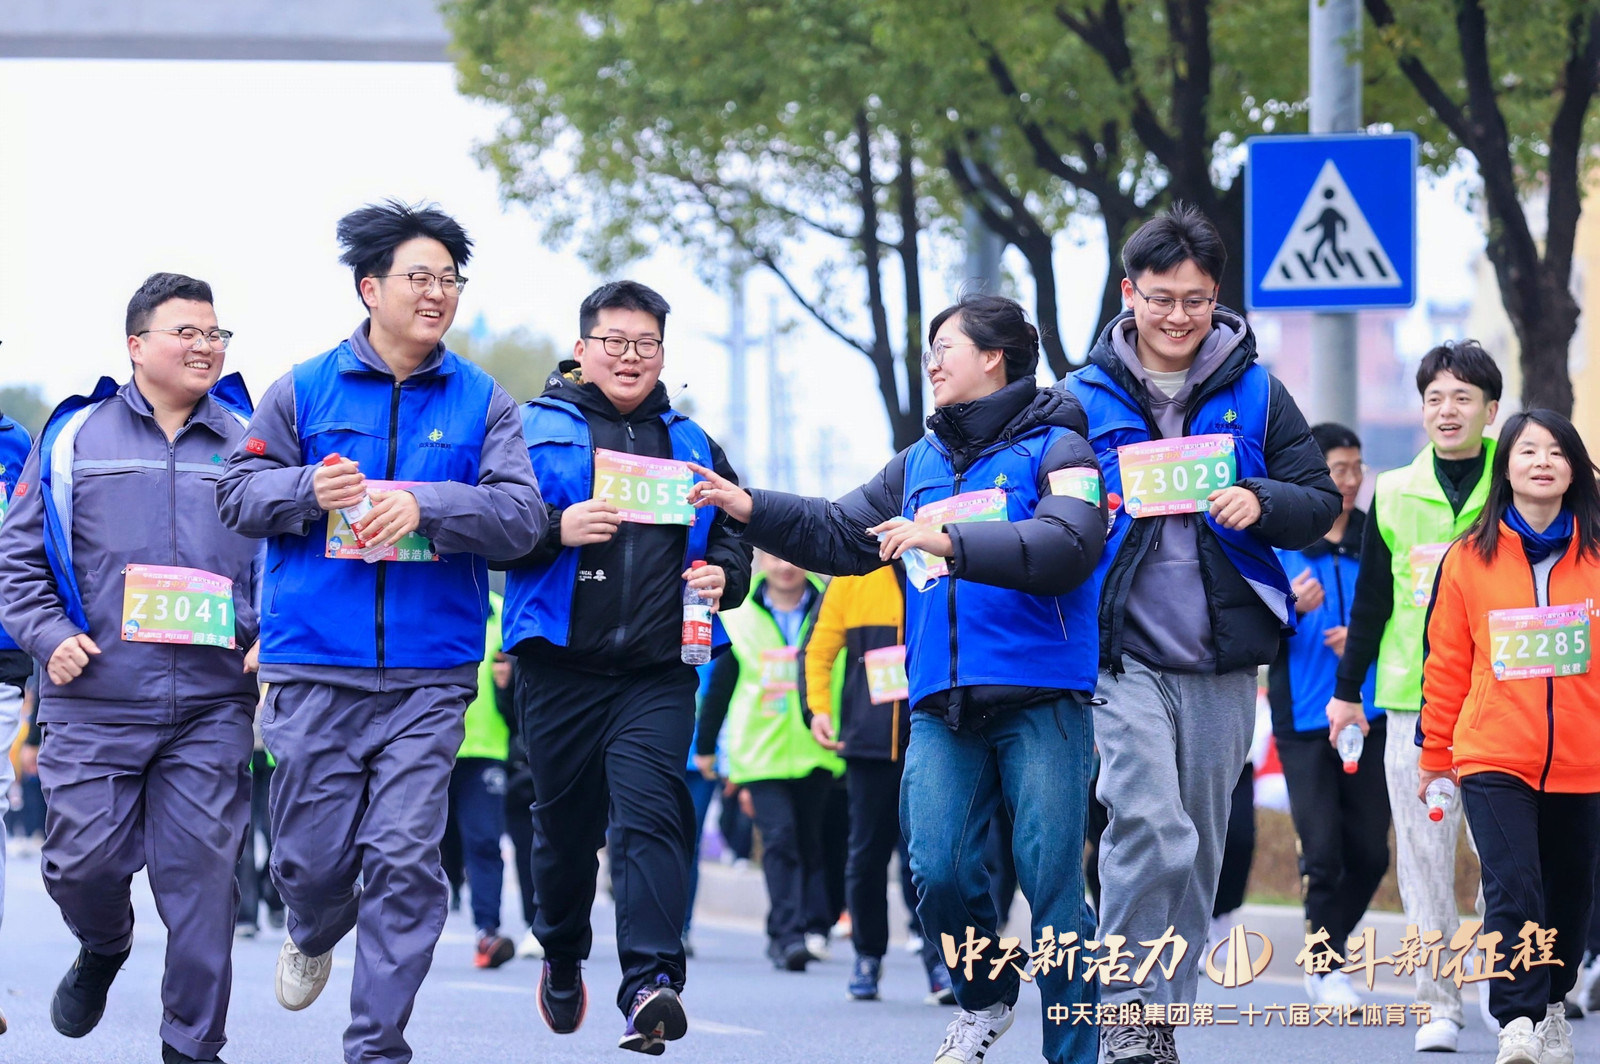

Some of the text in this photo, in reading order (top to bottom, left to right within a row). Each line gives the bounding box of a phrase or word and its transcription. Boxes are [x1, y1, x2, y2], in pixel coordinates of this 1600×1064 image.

[599, 475, 689, 506] Z3055
[1128, 462, 1230, 496] Z3029
[130, 593, 228, 627] Z3041
[1495, 630, 1586, 660] Z2285
